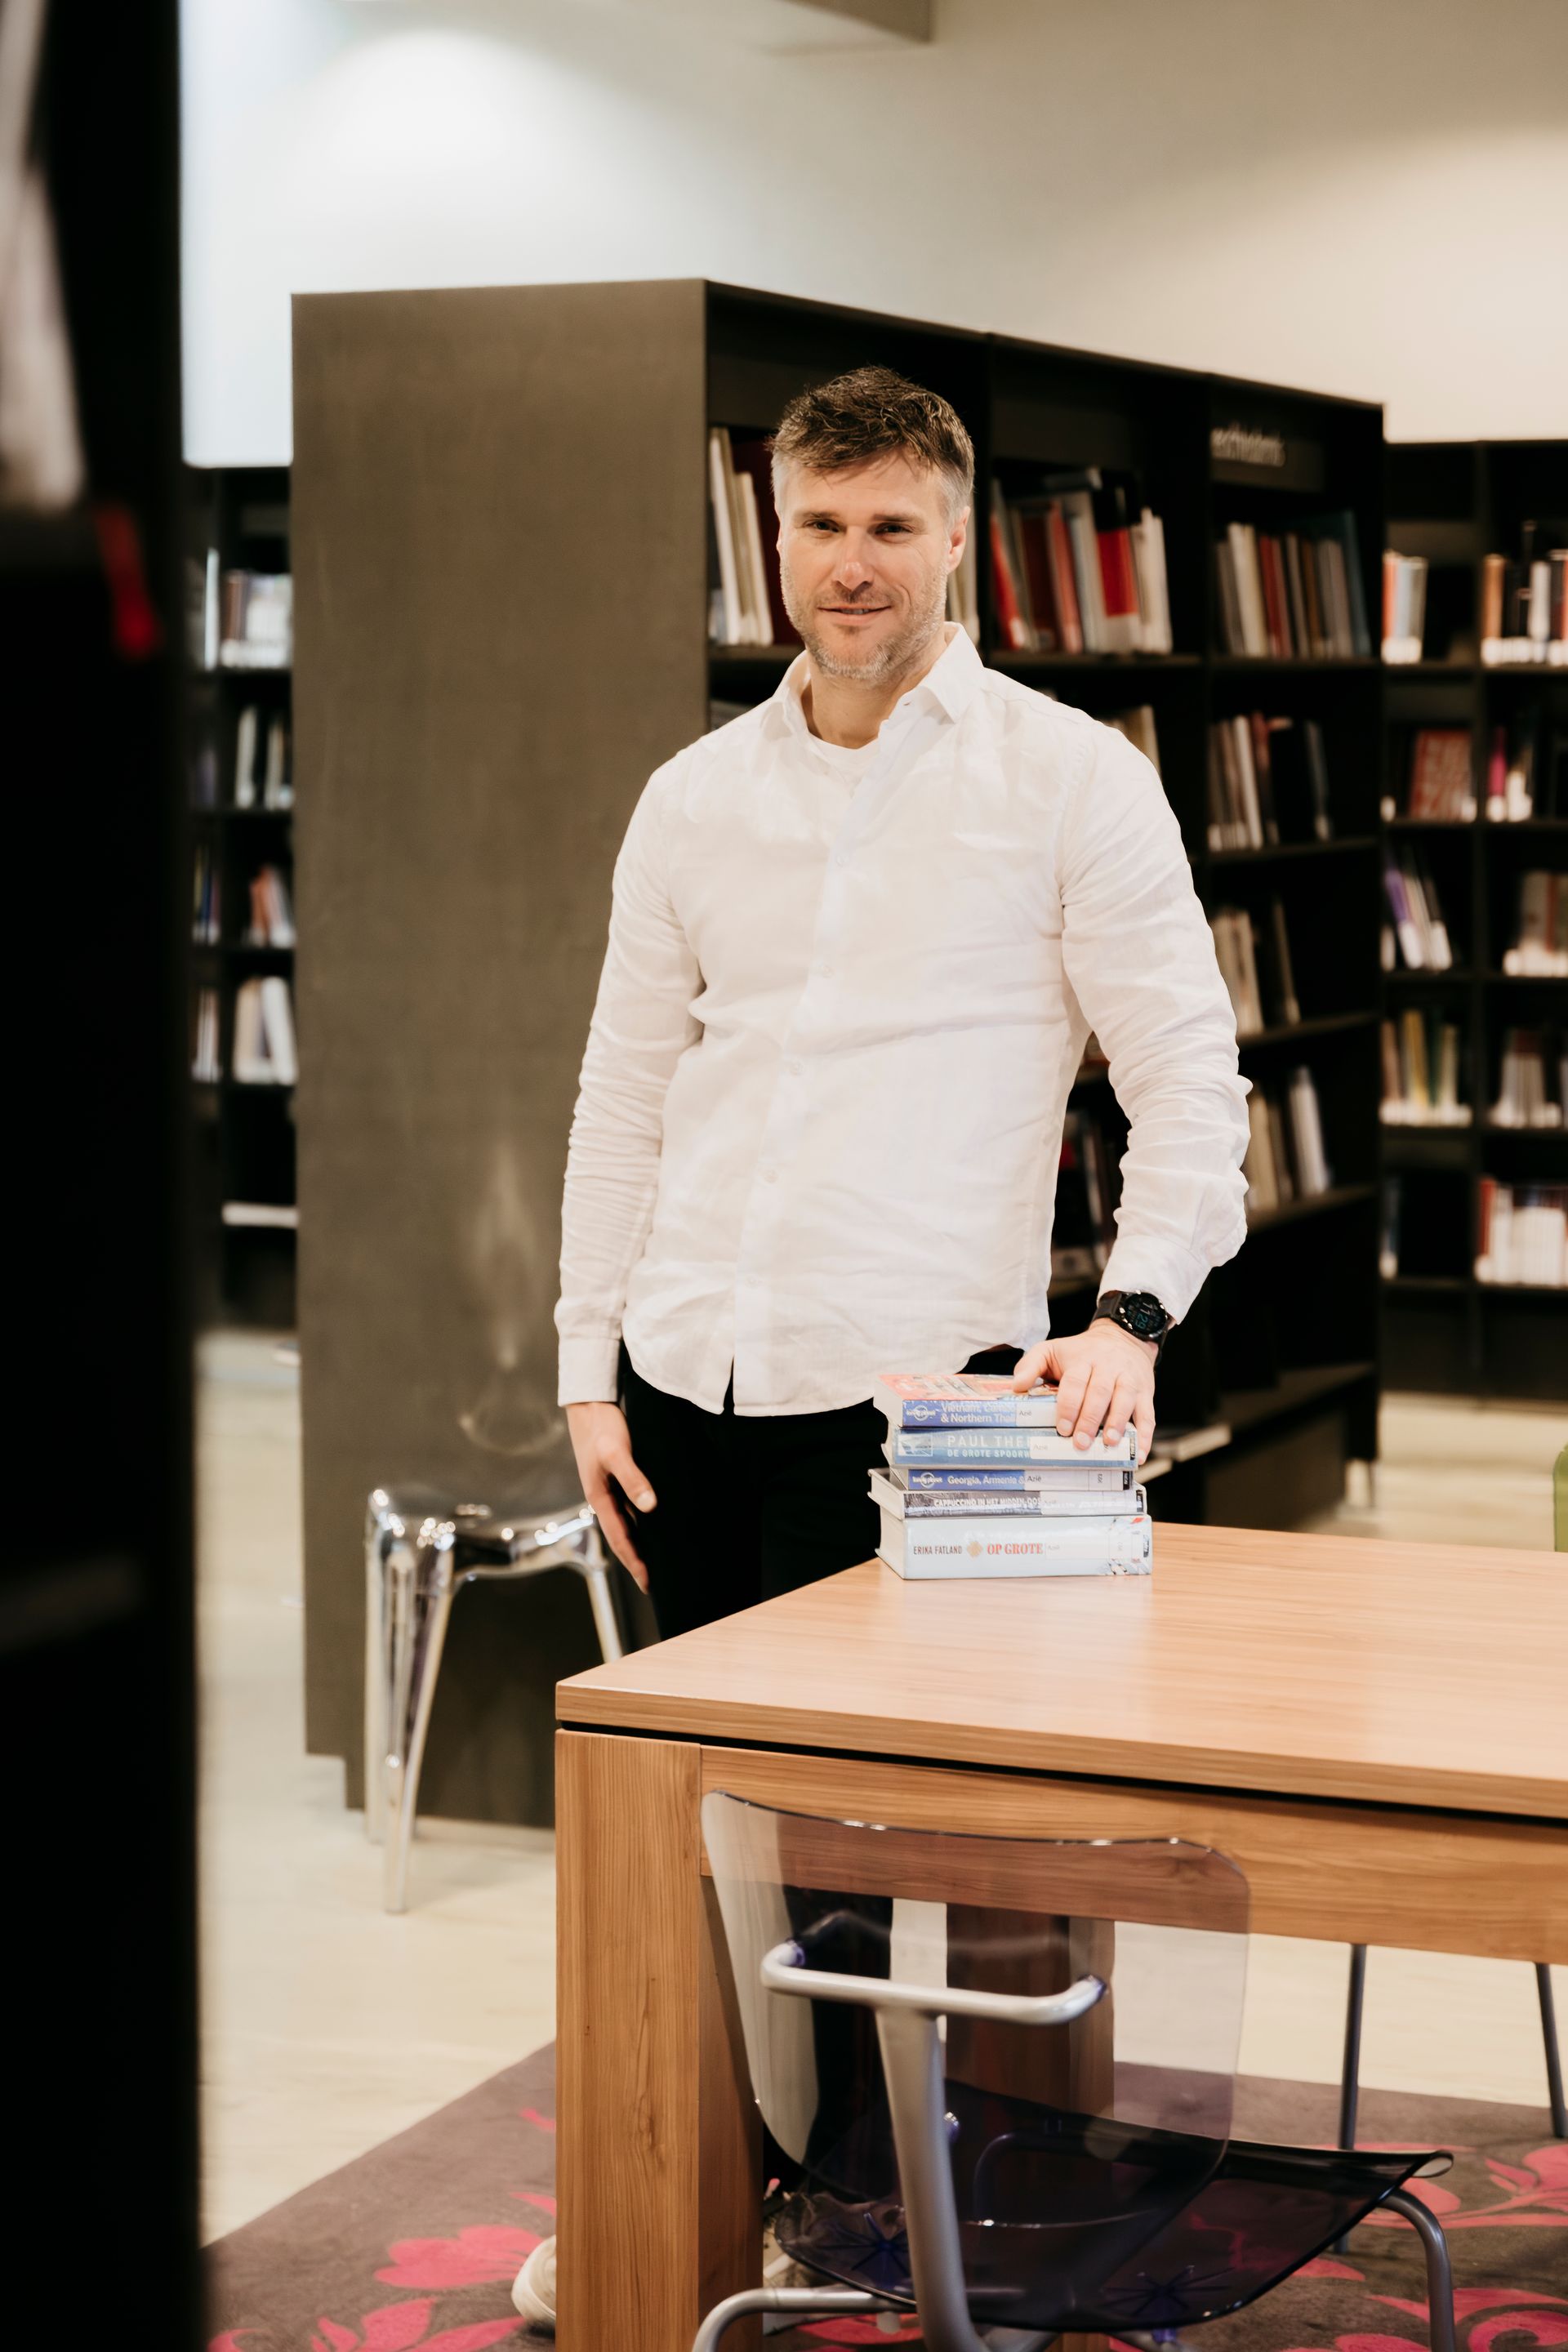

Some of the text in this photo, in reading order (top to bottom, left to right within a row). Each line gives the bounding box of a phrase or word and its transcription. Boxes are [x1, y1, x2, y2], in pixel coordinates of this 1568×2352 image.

[941, 1413, 949, 1423] &
[951, 1413, 991, 1423] Northern
[947, 1435, 988, 1447] PAUL
[947, 1449, 959, 1458] DE
[962, 1449, 991, 1458] GROTE
[947, 1475, 982, 1486] Georgia,
[983, 1475, 1018, 1485] Armenia
[933, 1499, 977, 1508] CAPPUCCINO
[913, 1545, 962, 1555] ERIKA FATLAND
[987, 1542, 1044, 1555] OP GROTE
